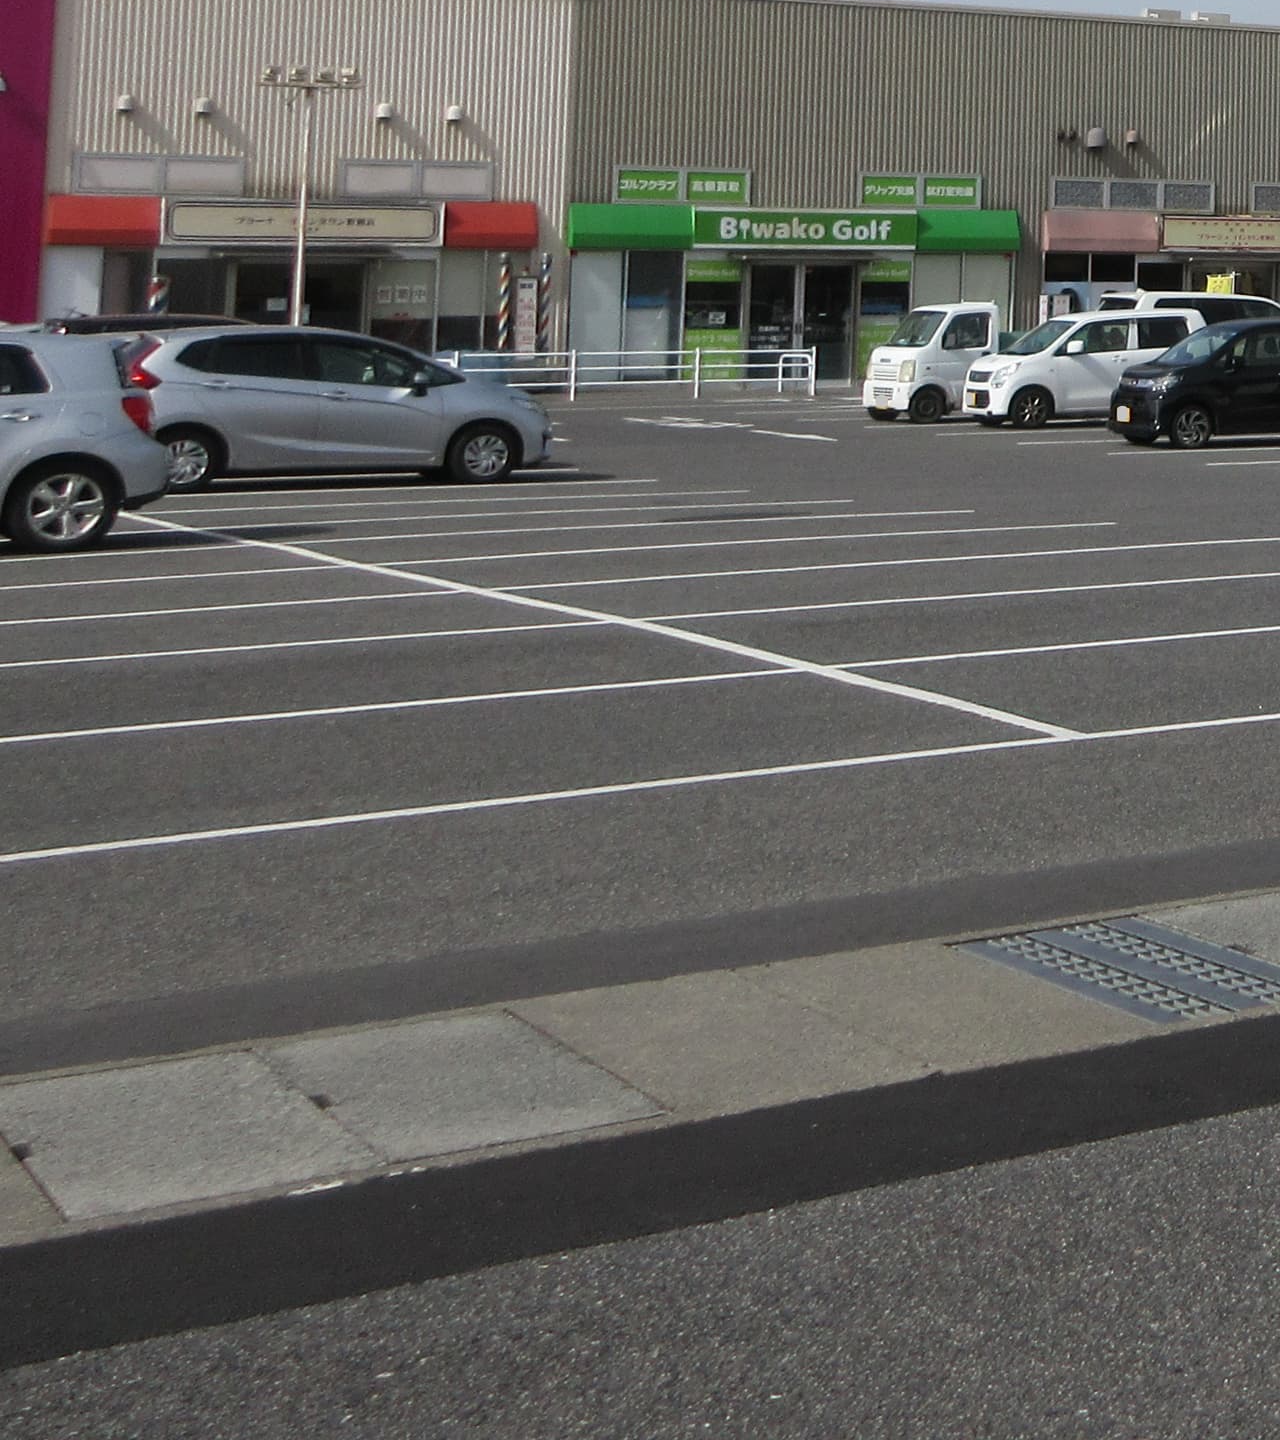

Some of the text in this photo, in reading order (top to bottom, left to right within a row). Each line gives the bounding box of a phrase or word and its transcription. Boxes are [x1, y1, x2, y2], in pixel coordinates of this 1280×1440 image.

[619, 178, 677, 191] ゴルフクラブ
[720, 216, 892, 241] Biwako Golf
